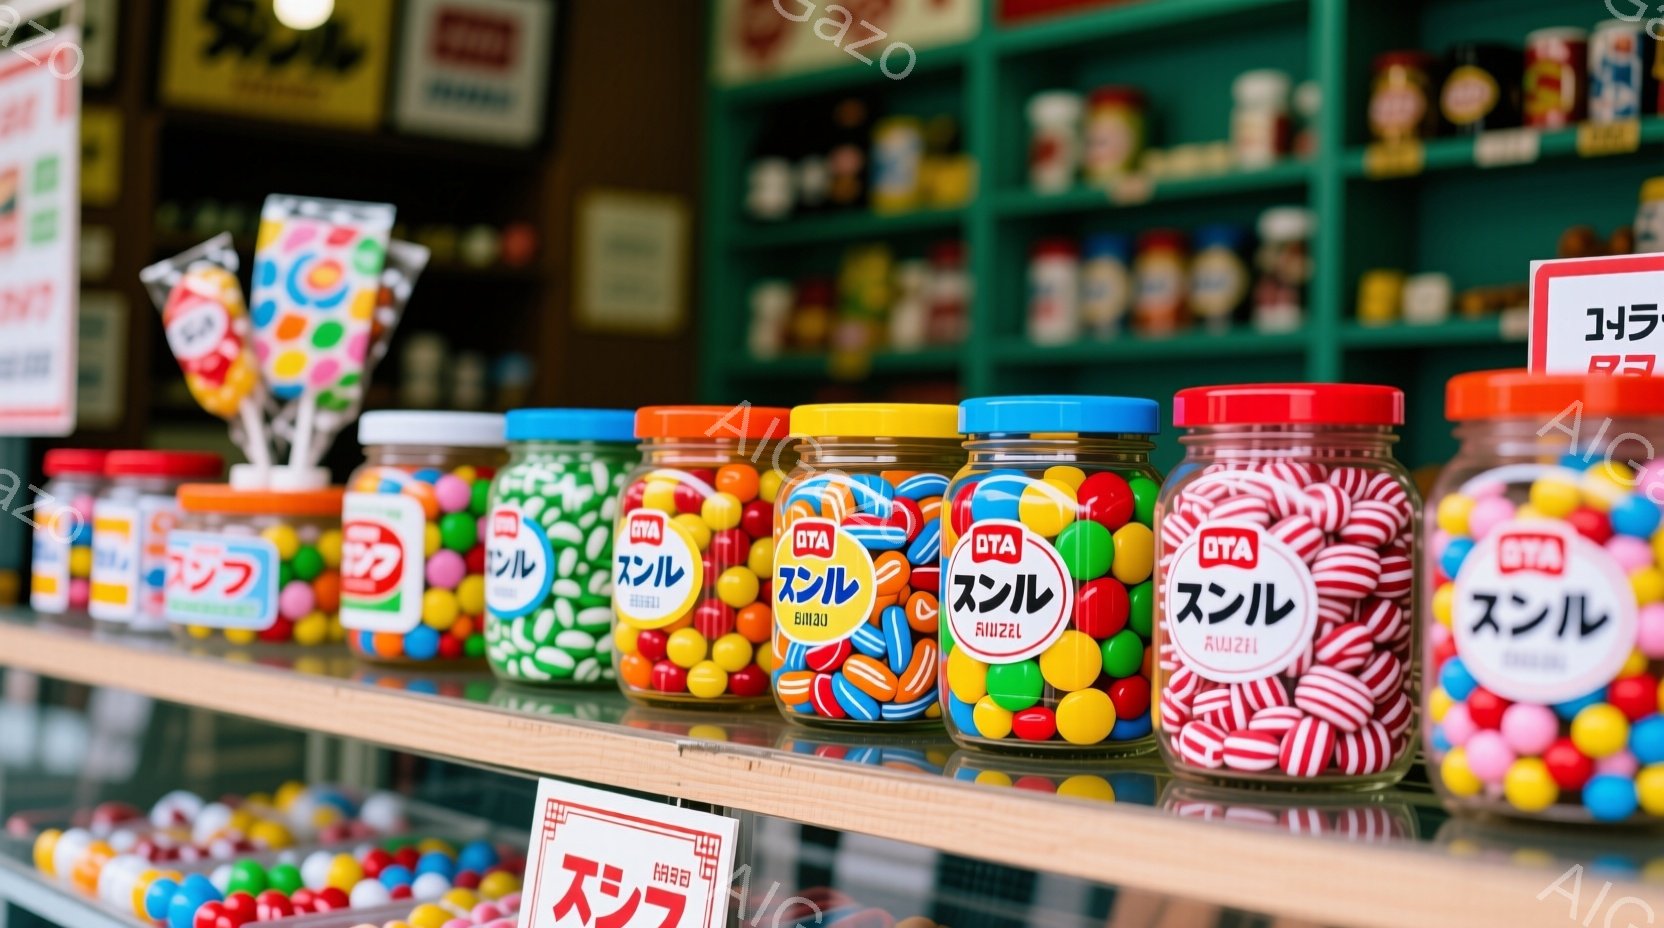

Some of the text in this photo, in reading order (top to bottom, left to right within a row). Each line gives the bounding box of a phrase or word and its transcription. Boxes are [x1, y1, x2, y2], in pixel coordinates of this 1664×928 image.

[796, 530, 830, 552] OTA
[974, 536, 1017, 556] OTA
[1202, 542, 1254, 562] OTA
[617, 558, 685, 588] スンル
[778, 566, 860, 605] スンル
[951, 574, 1053, 614] スンル
[1176, 582, 1296, 626] スンル
[1471, 593, 1609, 637] スンル
